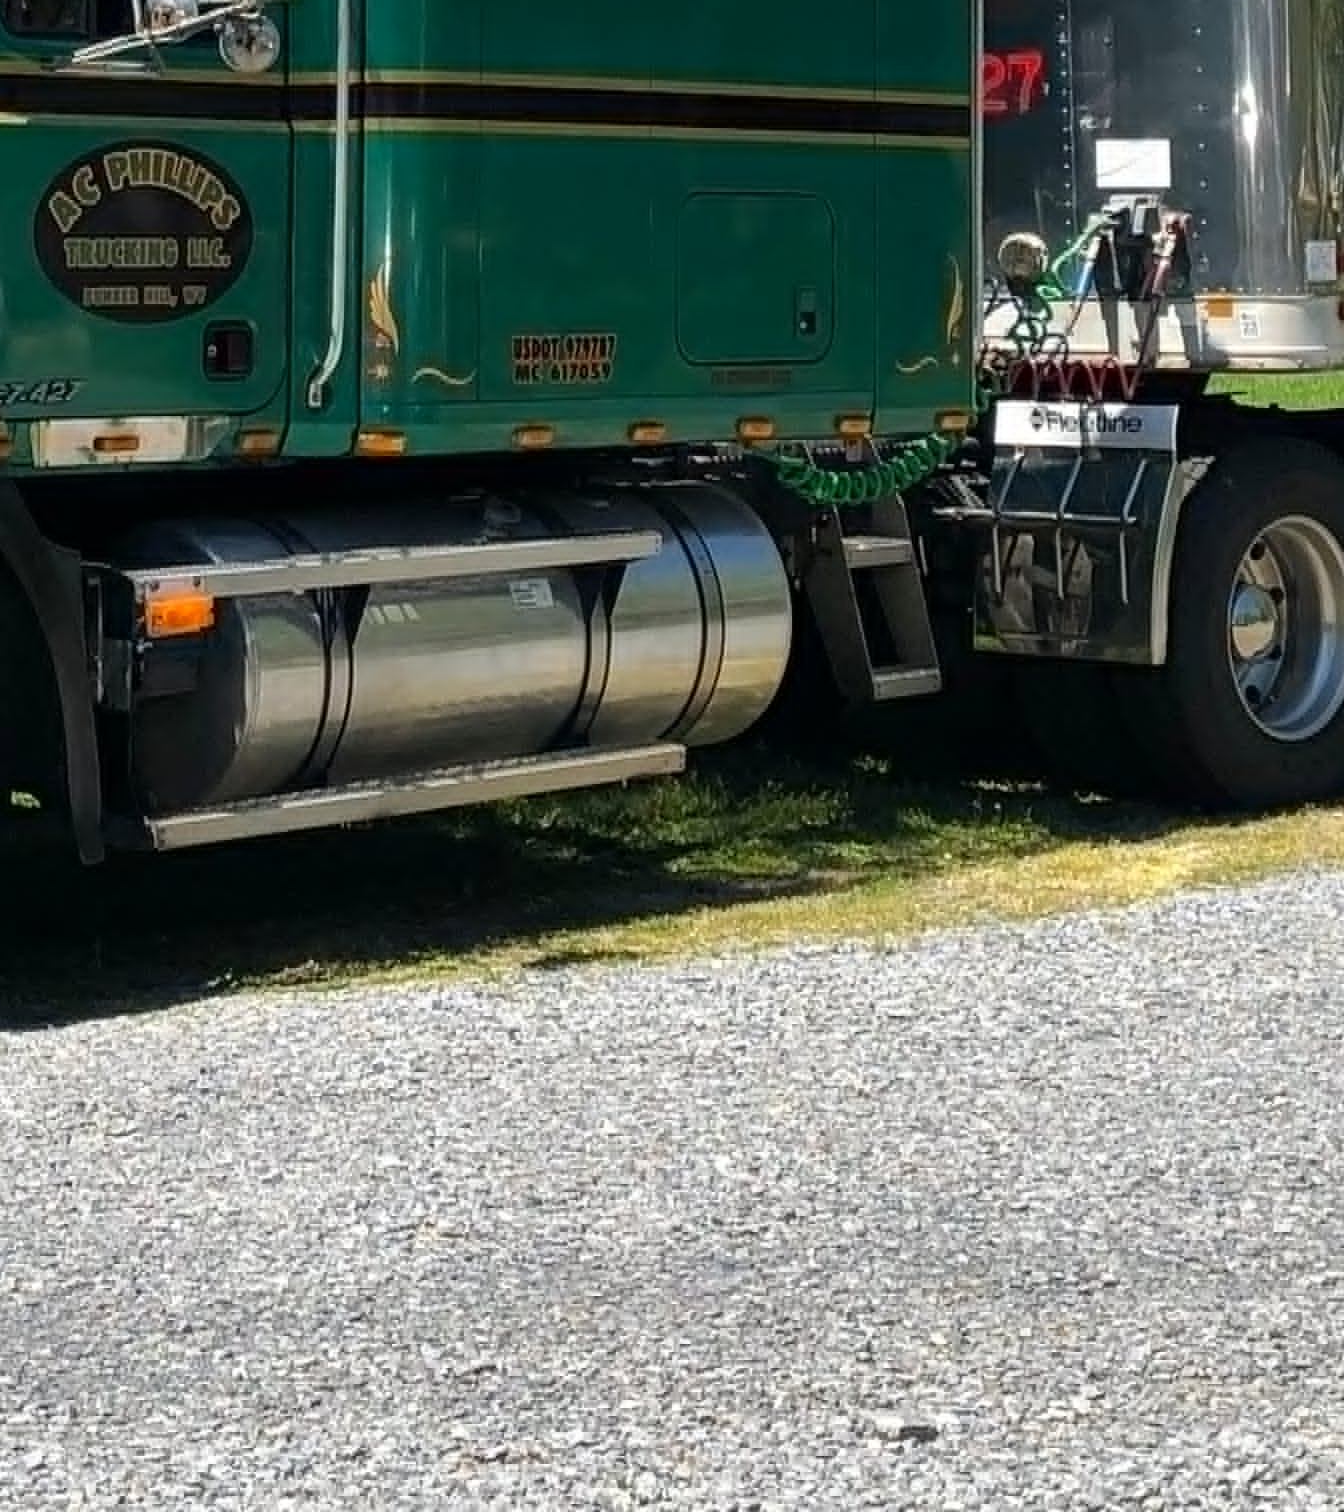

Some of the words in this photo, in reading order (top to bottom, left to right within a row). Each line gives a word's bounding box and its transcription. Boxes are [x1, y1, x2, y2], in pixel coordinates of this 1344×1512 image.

[104, 148, 240, 231] PHILLIPS
[64, 237, 179, 268] TRUCKING
[512, 334, 560, 361] USDOT
[513, 360, 544, 384] MC
